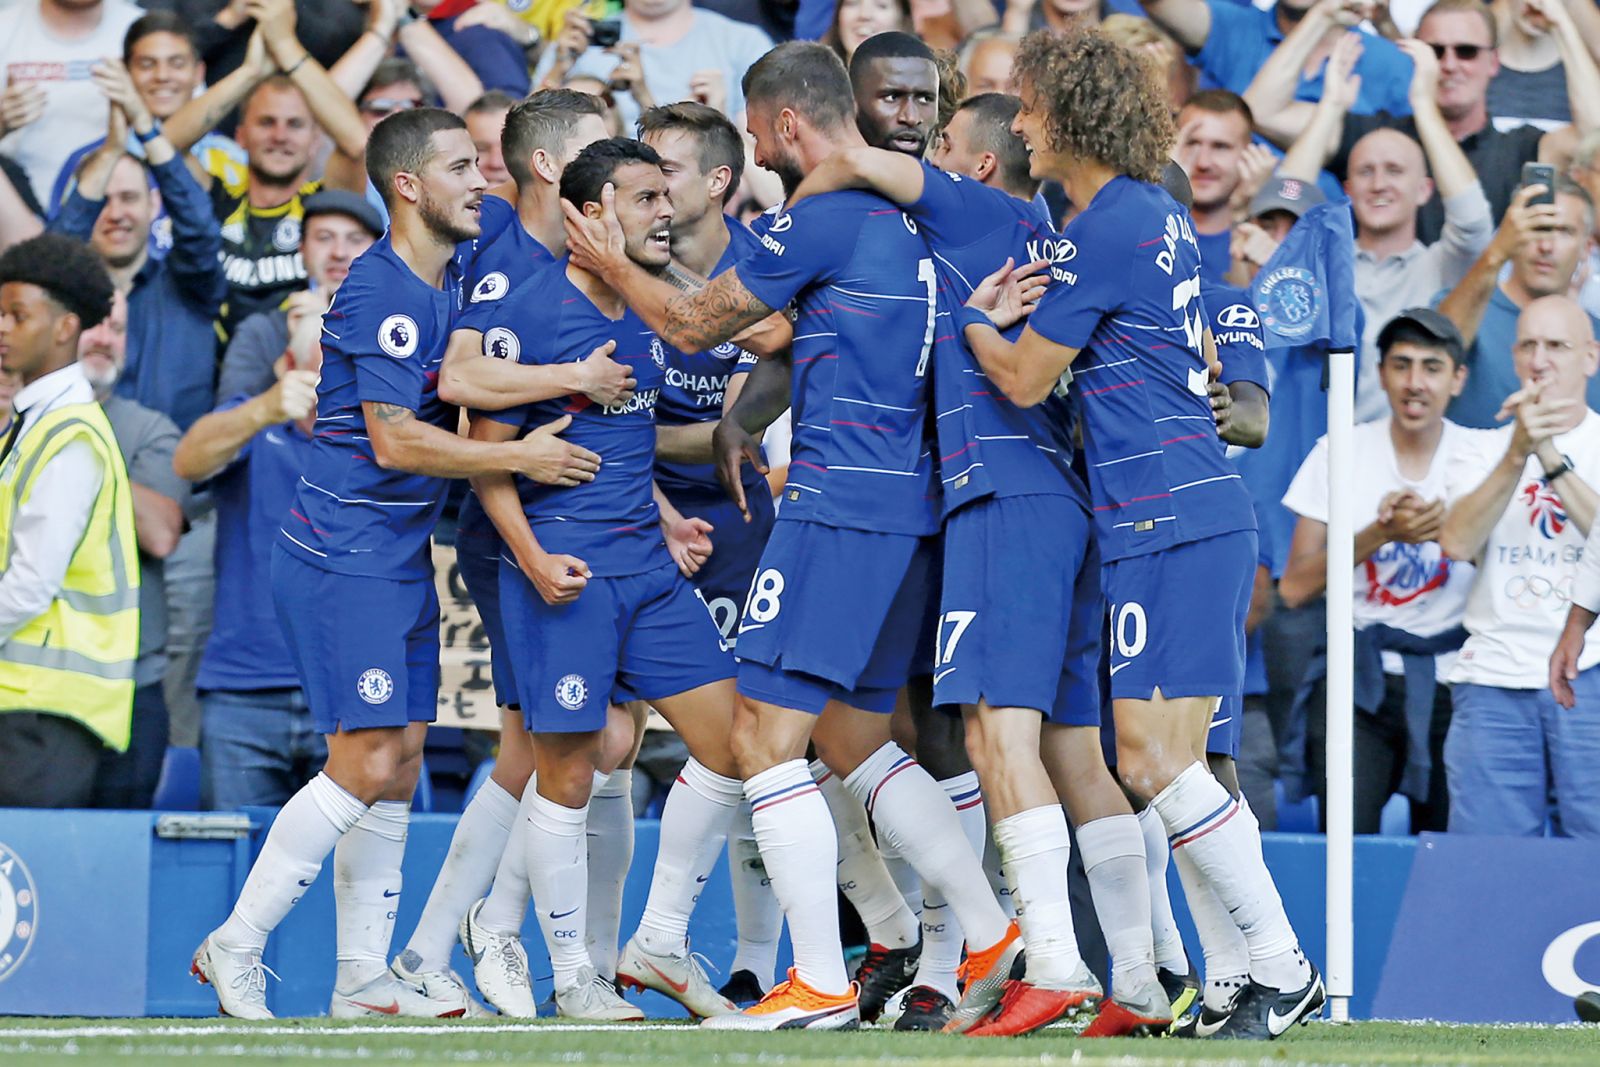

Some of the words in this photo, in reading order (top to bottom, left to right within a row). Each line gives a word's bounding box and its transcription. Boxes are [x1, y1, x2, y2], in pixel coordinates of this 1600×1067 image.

[1155, 213, 1179, 276] DAVID
[1259, 267, 1303, 295] CHELSEA
[1497, 544, 1556, 566] TEAM
[554, 929, 577, 939] CFC
